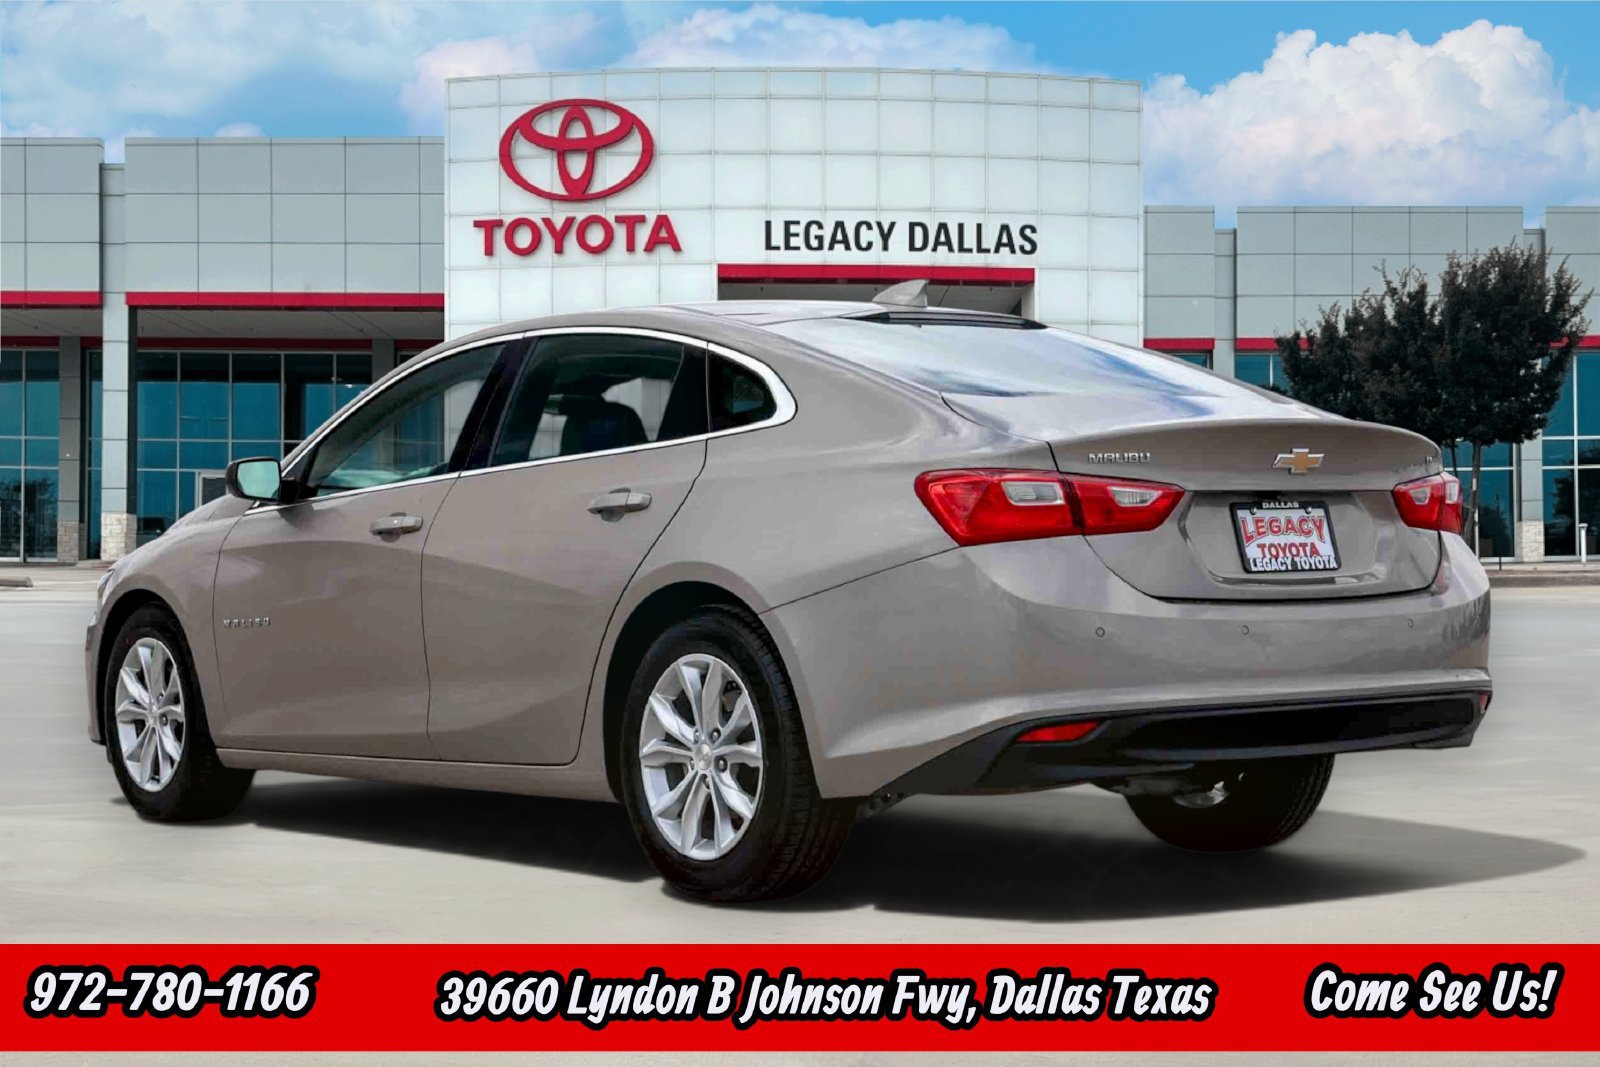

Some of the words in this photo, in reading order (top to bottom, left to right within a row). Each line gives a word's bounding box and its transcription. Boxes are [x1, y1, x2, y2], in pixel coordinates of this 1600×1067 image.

[474, 214, 681, 256] TOYOTA
[765, 220, 896, 252] LEGACY
[908, 221, 1038, 255] DALLAS
[1088, 452, 1151, 464] MALIBU
[1240, 516, 1326, 546] LEGACY
[1257, 542, 1320, 559] TOYOTA
[1250, 558, 1291, 571] LEGACY
[1295, 556, 1338, 569] TOYOTA
